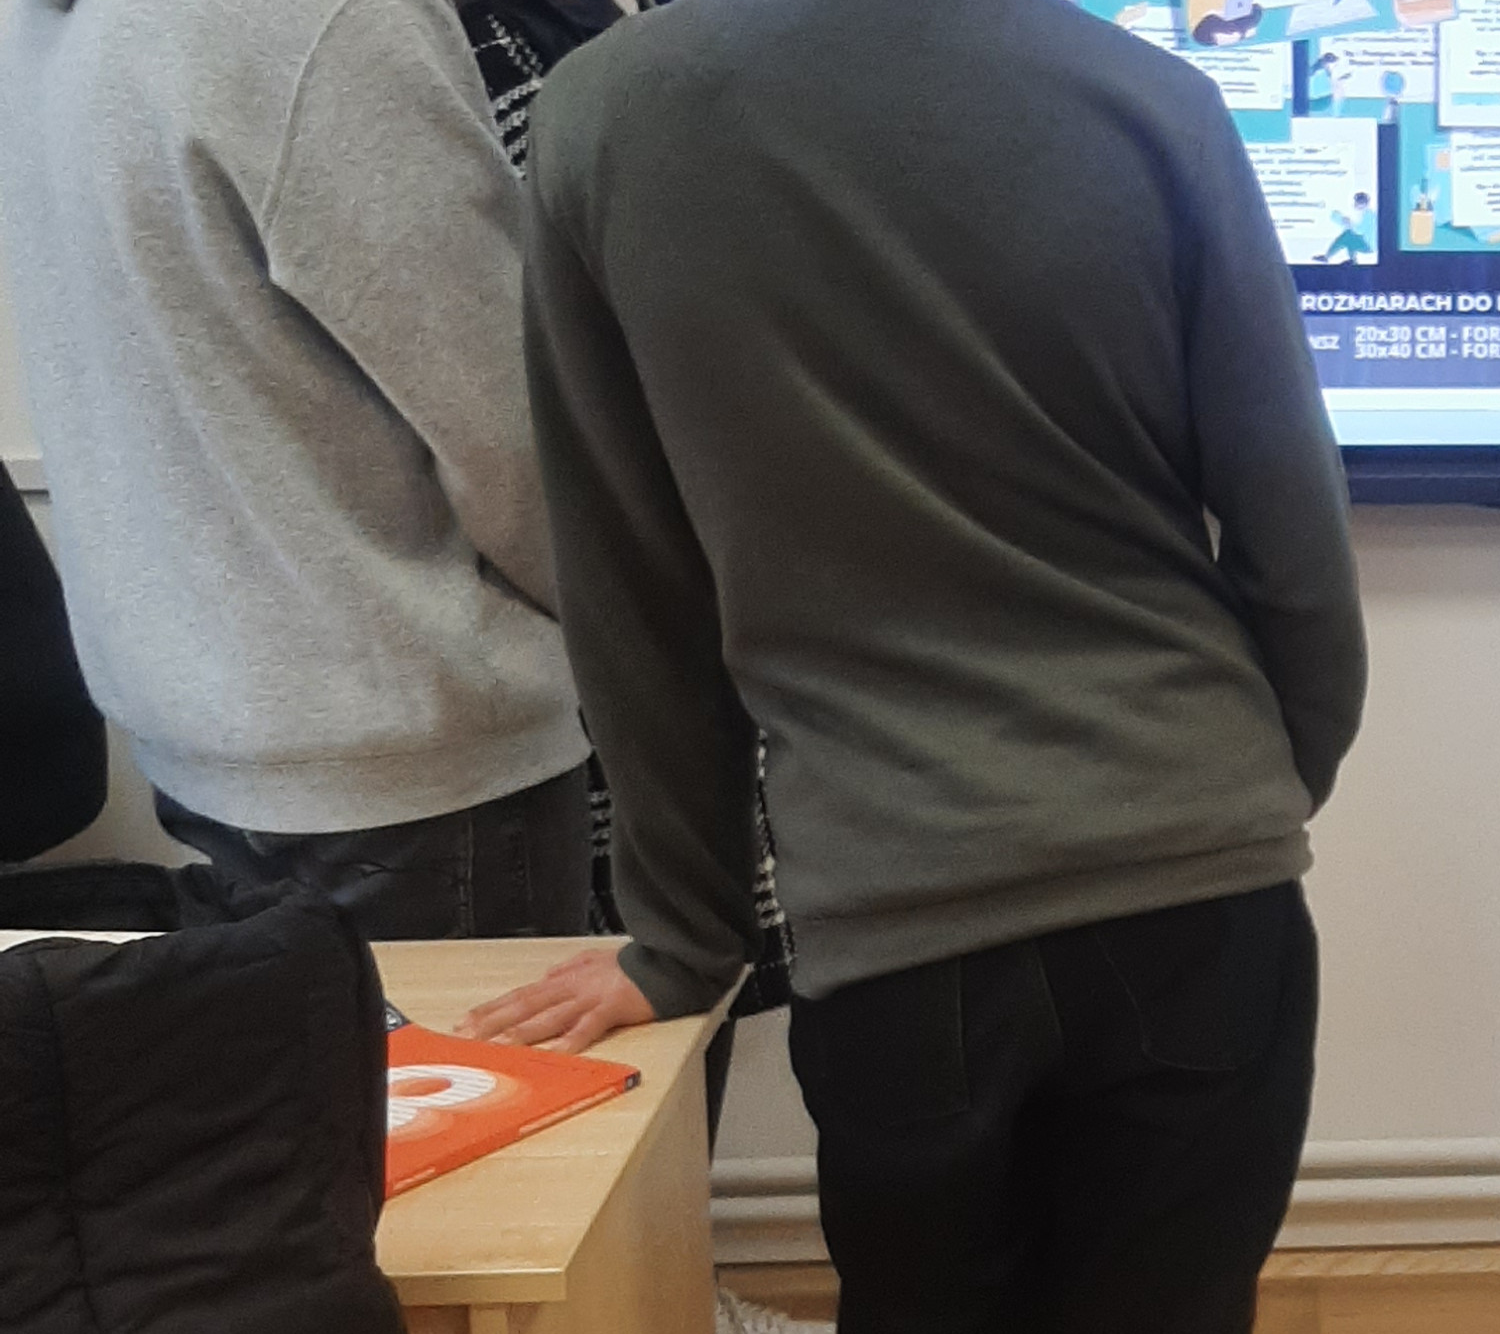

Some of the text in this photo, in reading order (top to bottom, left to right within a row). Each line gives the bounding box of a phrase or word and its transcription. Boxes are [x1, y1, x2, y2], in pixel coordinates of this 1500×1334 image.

[1301, 294, 1453, 312] ROZMIARACH
[1457, 294, 1493, 312] DO
[1355, 326, 1412, 342] 20x30
[1415, 326, 1447, 342] CM
[1354, 342, 1412, 359] 30x40
[1415, 342, 1447, 359] CM
